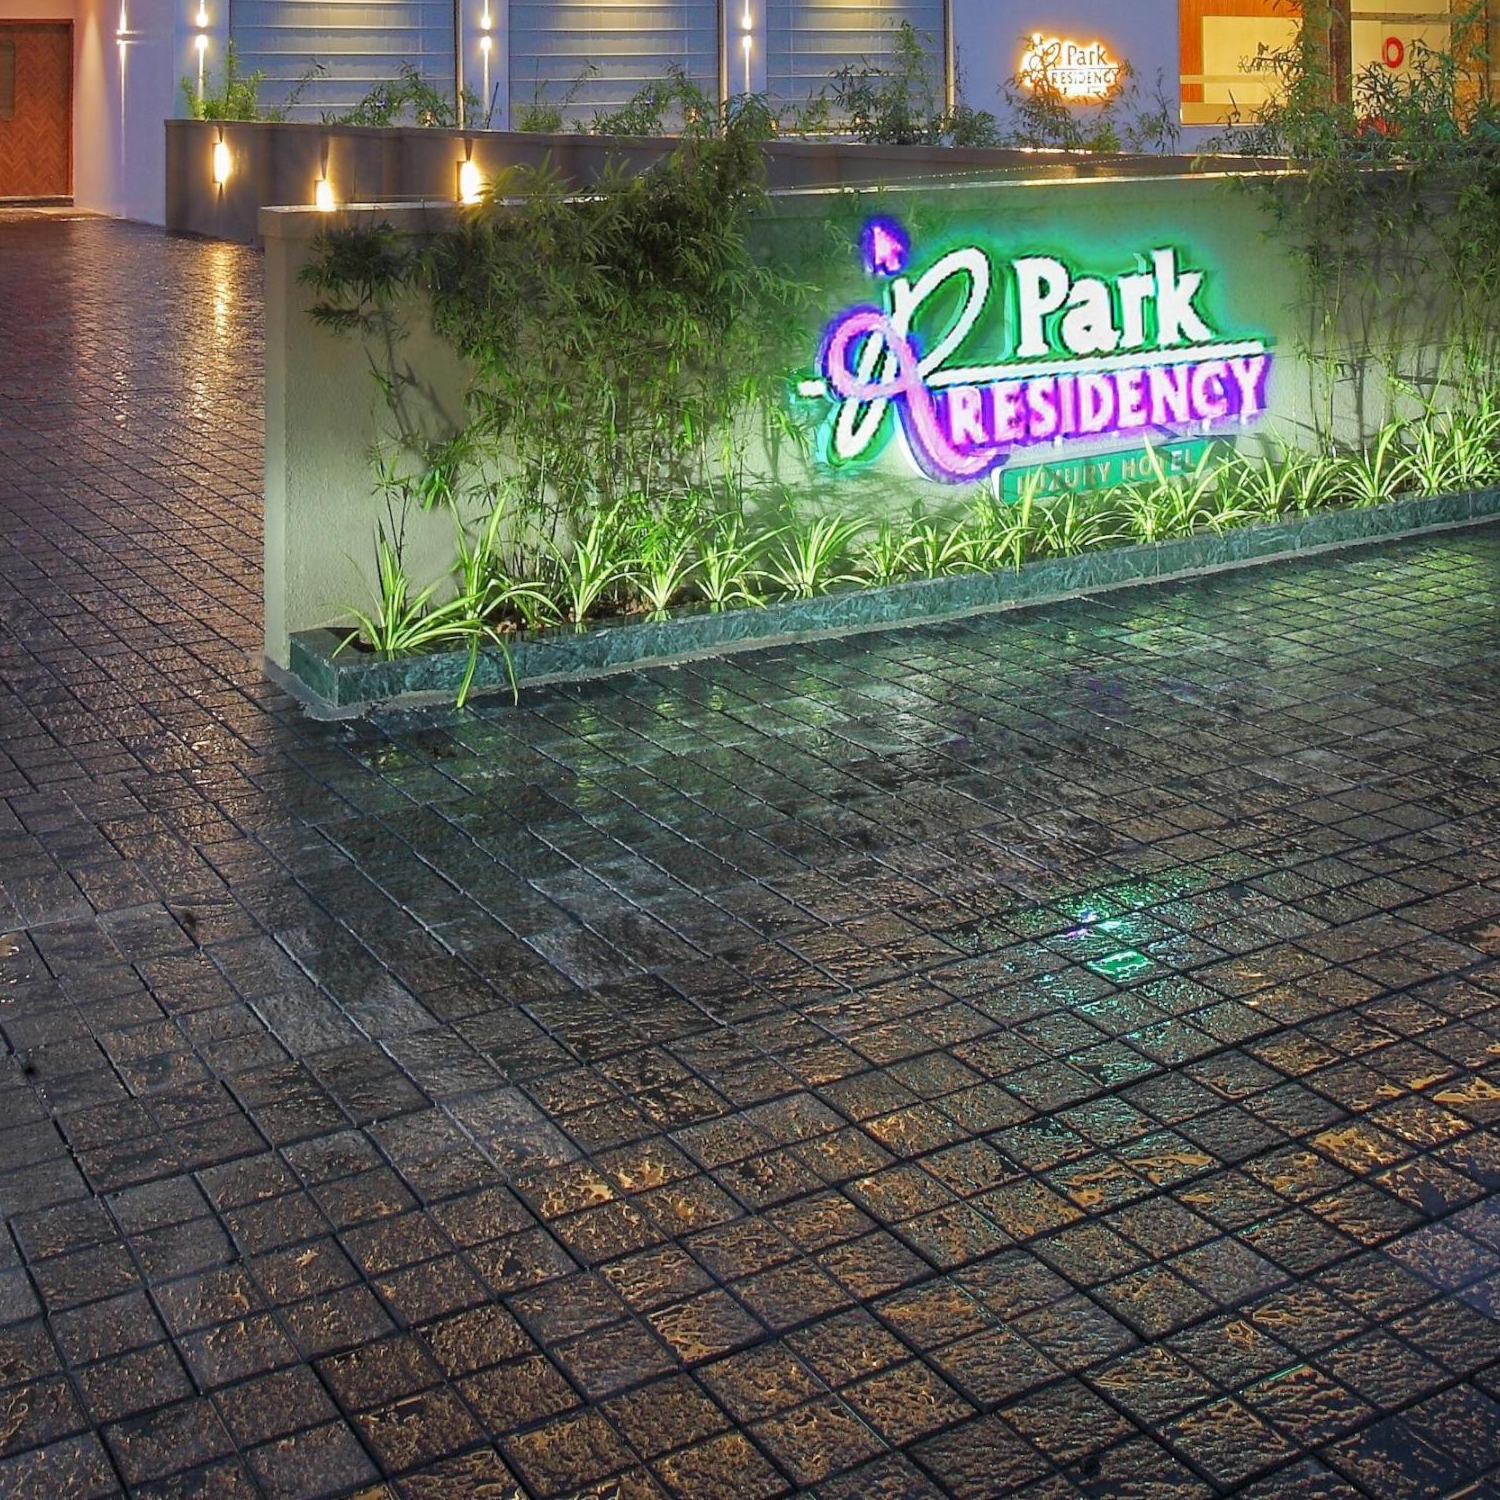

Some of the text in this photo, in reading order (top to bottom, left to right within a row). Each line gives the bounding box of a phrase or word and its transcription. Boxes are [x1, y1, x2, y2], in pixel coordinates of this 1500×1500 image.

[1051, 68, 1120, 85] RESIDENCY
[1067, 44, 1108, 66] Park
[1011, 247, 1216, 359] Park
[948, 355, 1268, 448] RESIDENCY
